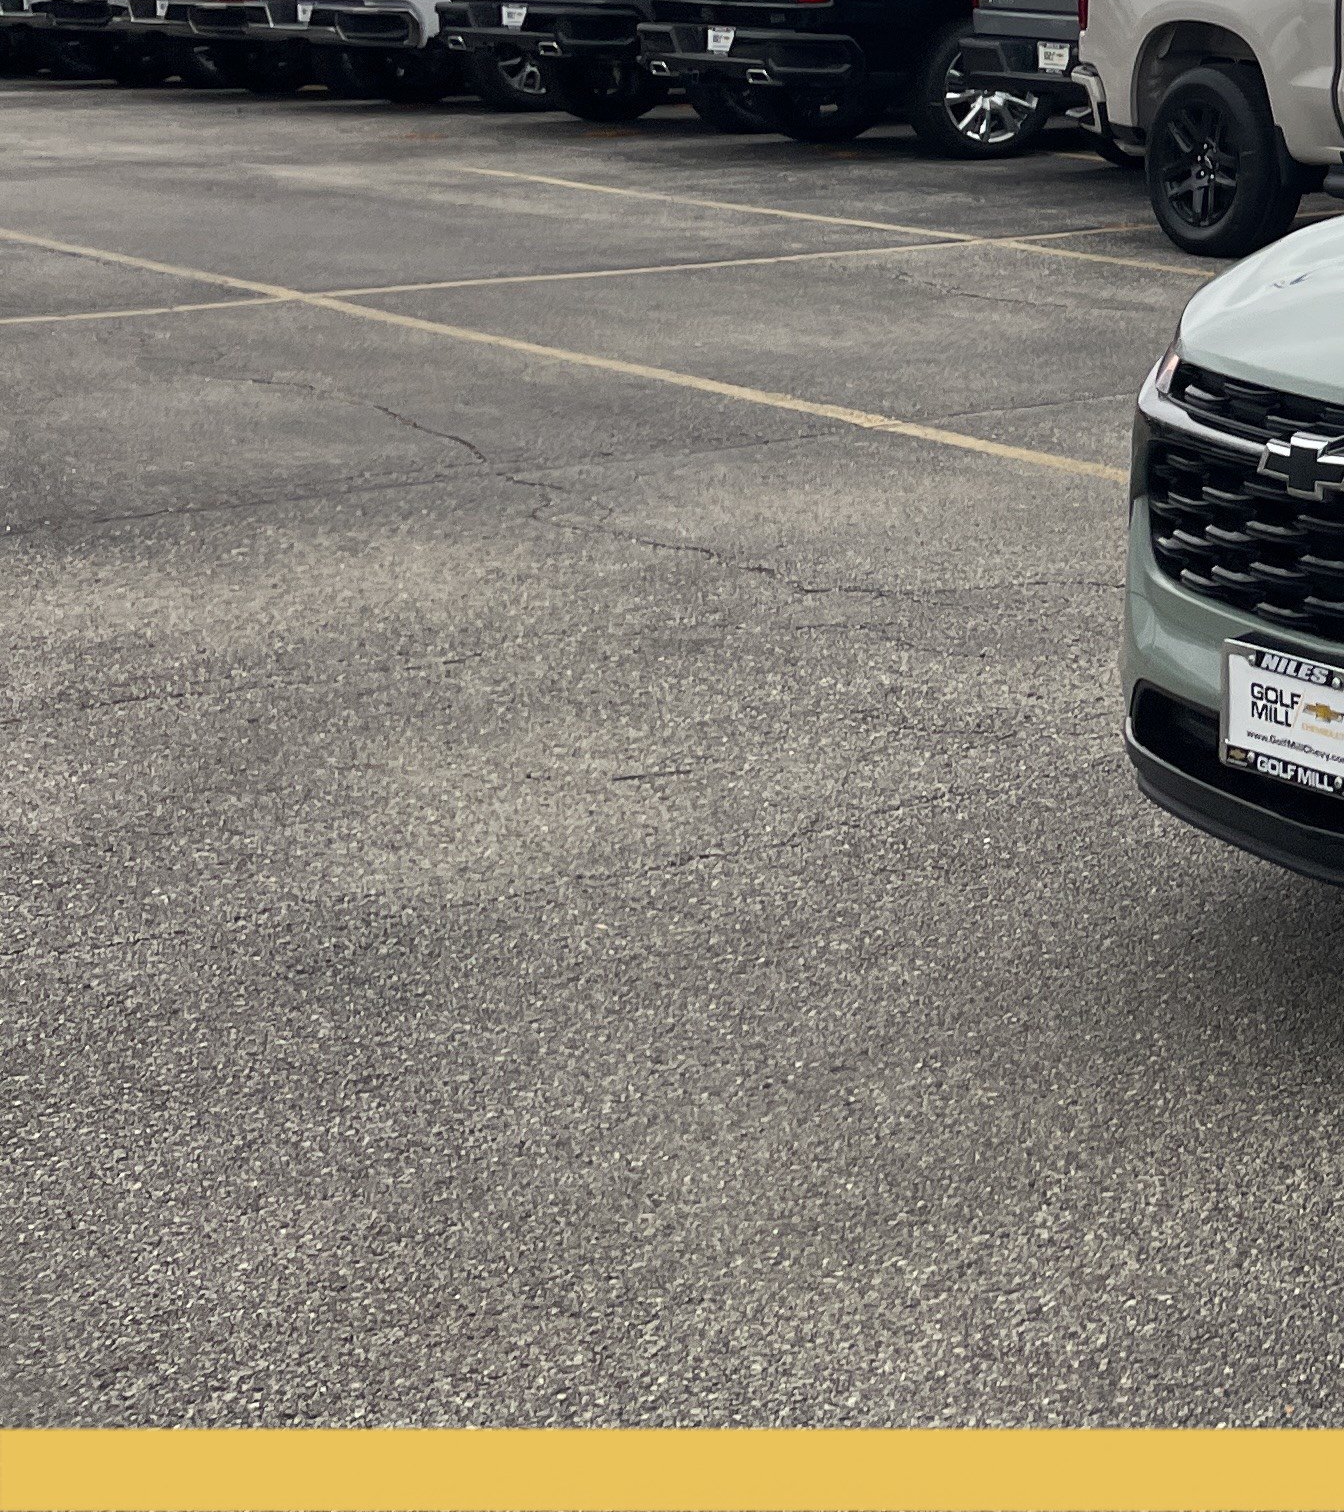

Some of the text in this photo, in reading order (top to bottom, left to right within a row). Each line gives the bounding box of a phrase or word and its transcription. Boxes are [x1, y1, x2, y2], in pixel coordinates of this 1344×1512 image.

[1260, 653, 1330, 685] NILES
[1250, 681, 1302, 710] GOLF
[1250, 700, 1293, 728] MILL
[1256, 755, 1297, 781] GOLF
[1297, 767, 1334, 792] MILL
